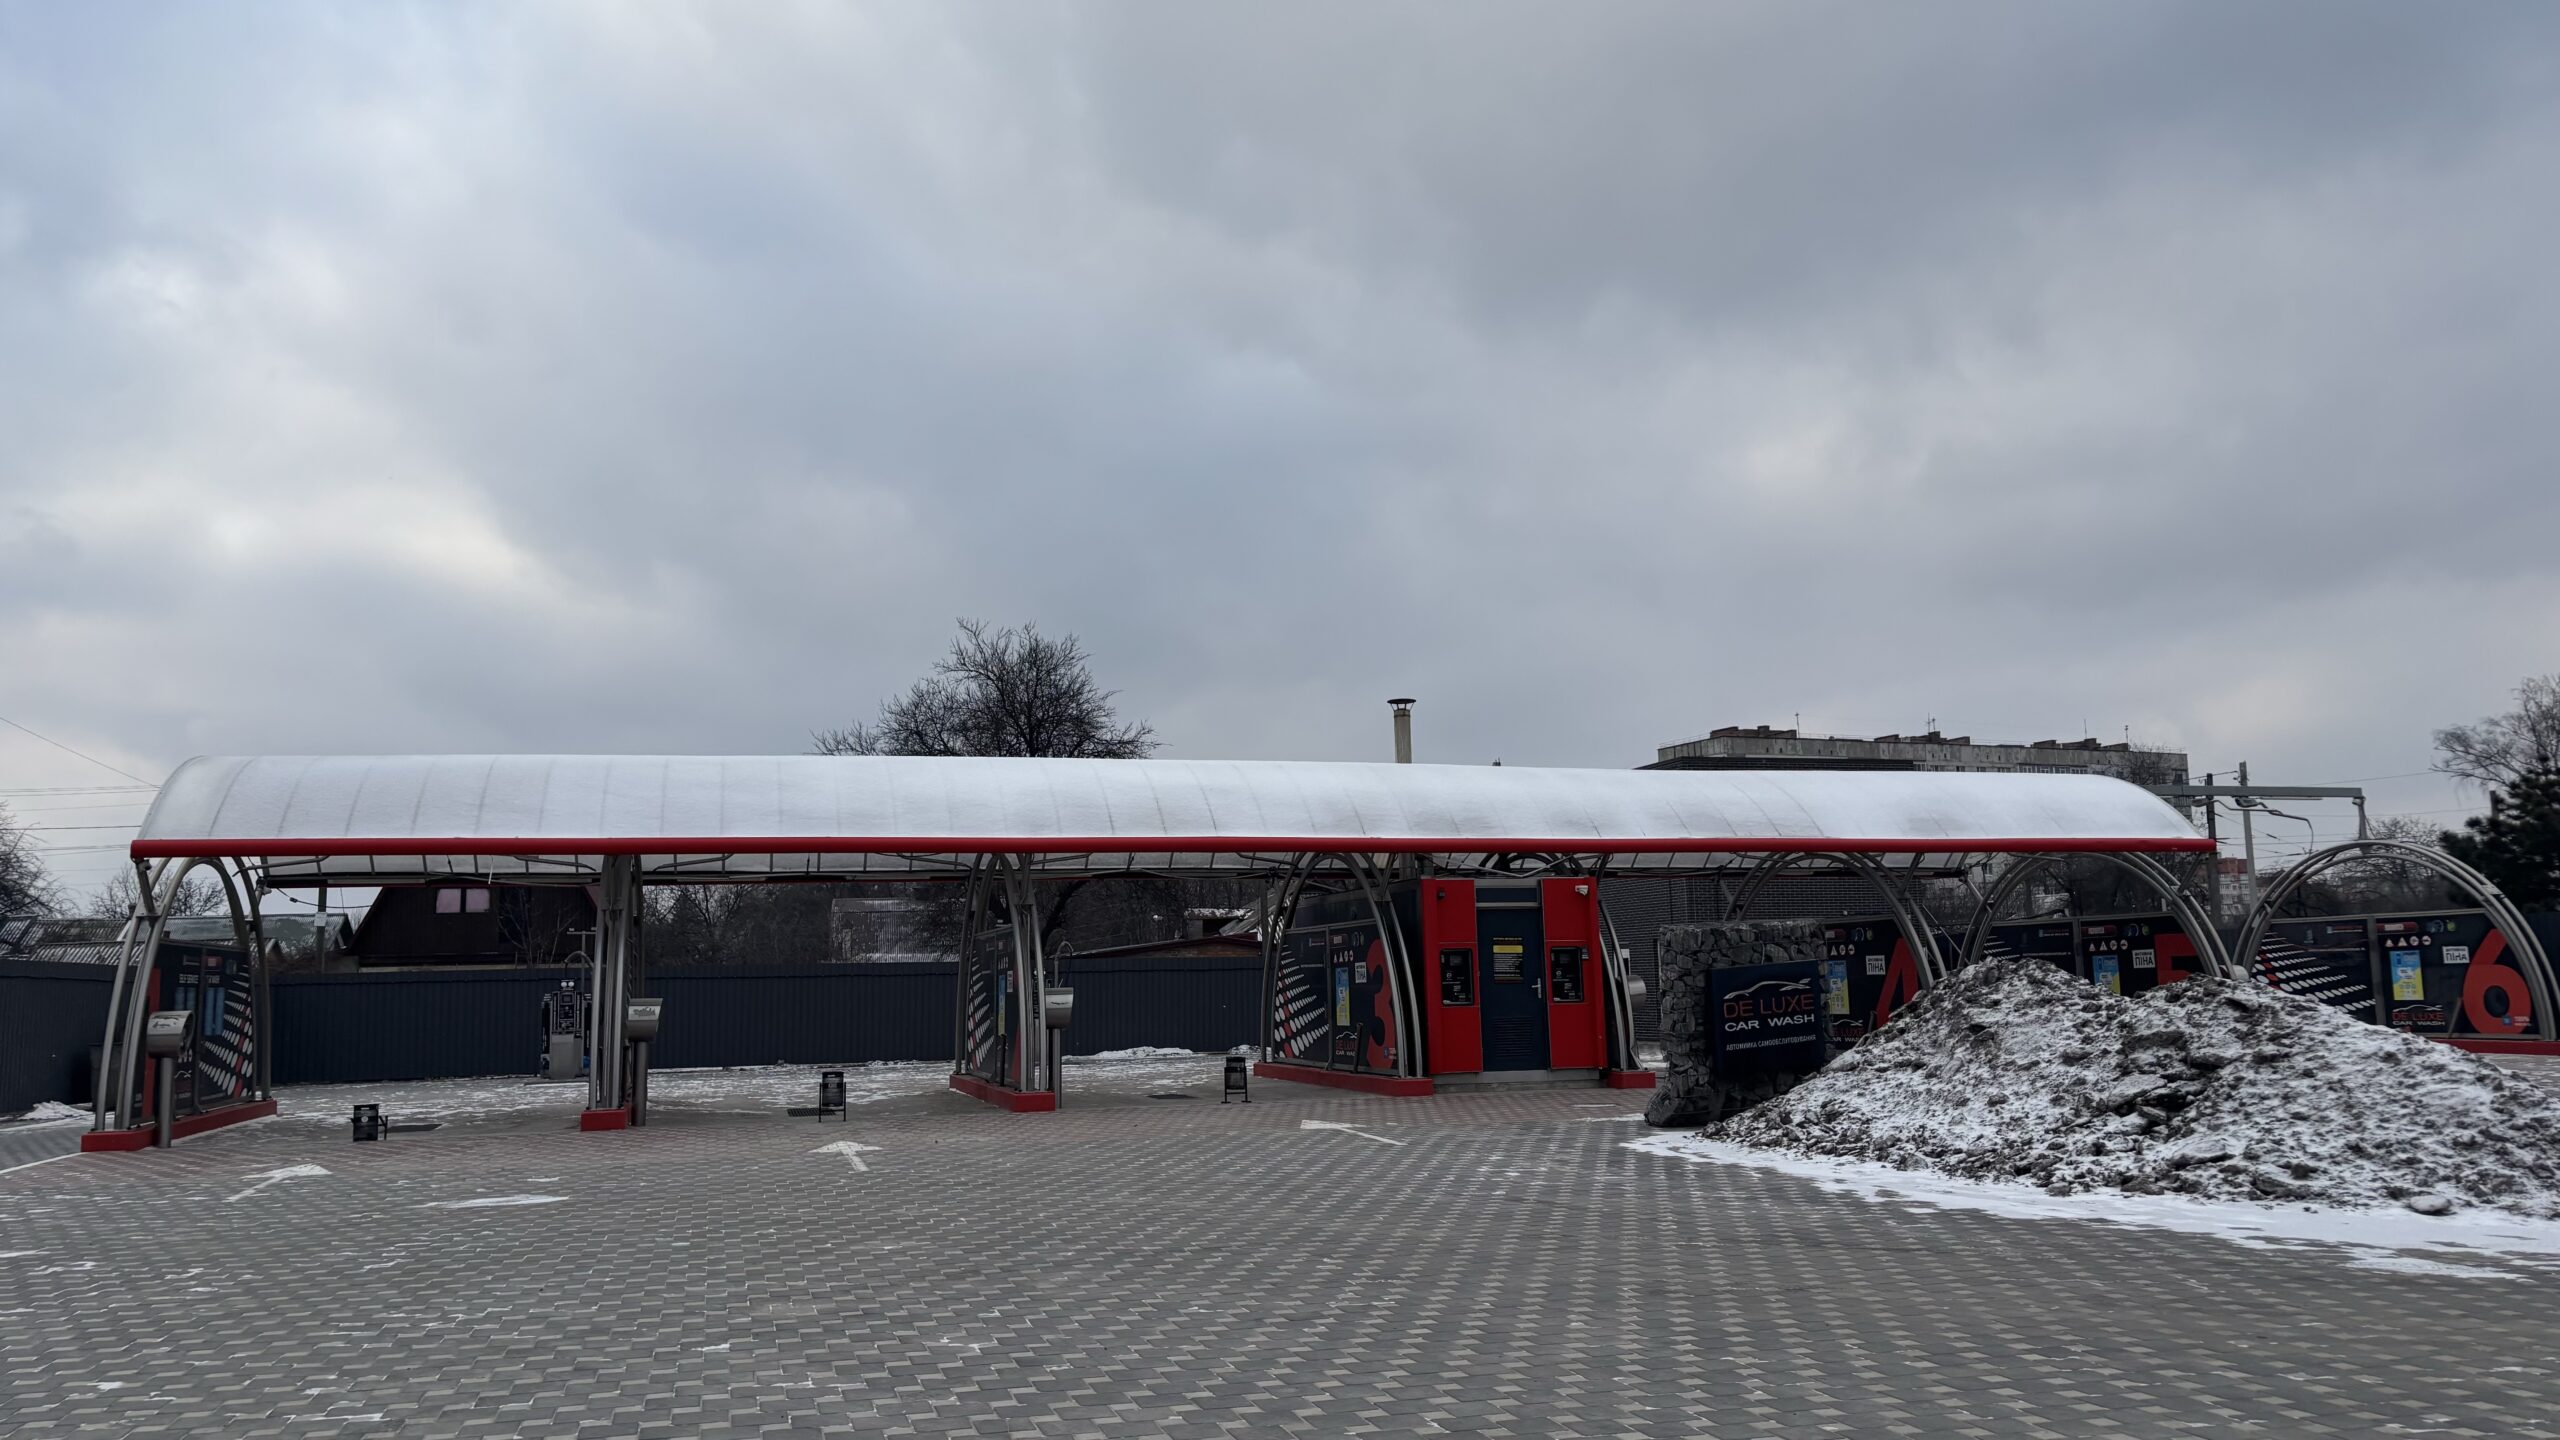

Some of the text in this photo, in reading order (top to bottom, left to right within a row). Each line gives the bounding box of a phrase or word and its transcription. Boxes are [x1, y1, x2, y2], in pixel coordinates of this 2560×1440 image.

[1868, 962, 1884, 973] ПІНА
[2135, 956, 2154, 966] ПІНА
[2463, 928, 2533, 1034] 6
[1366, 938, 1397, 1069] 3
[1723, 993, 1815, 1018] DE LUXE
[1724, 1013, 1815, 1032] CAR WASH
